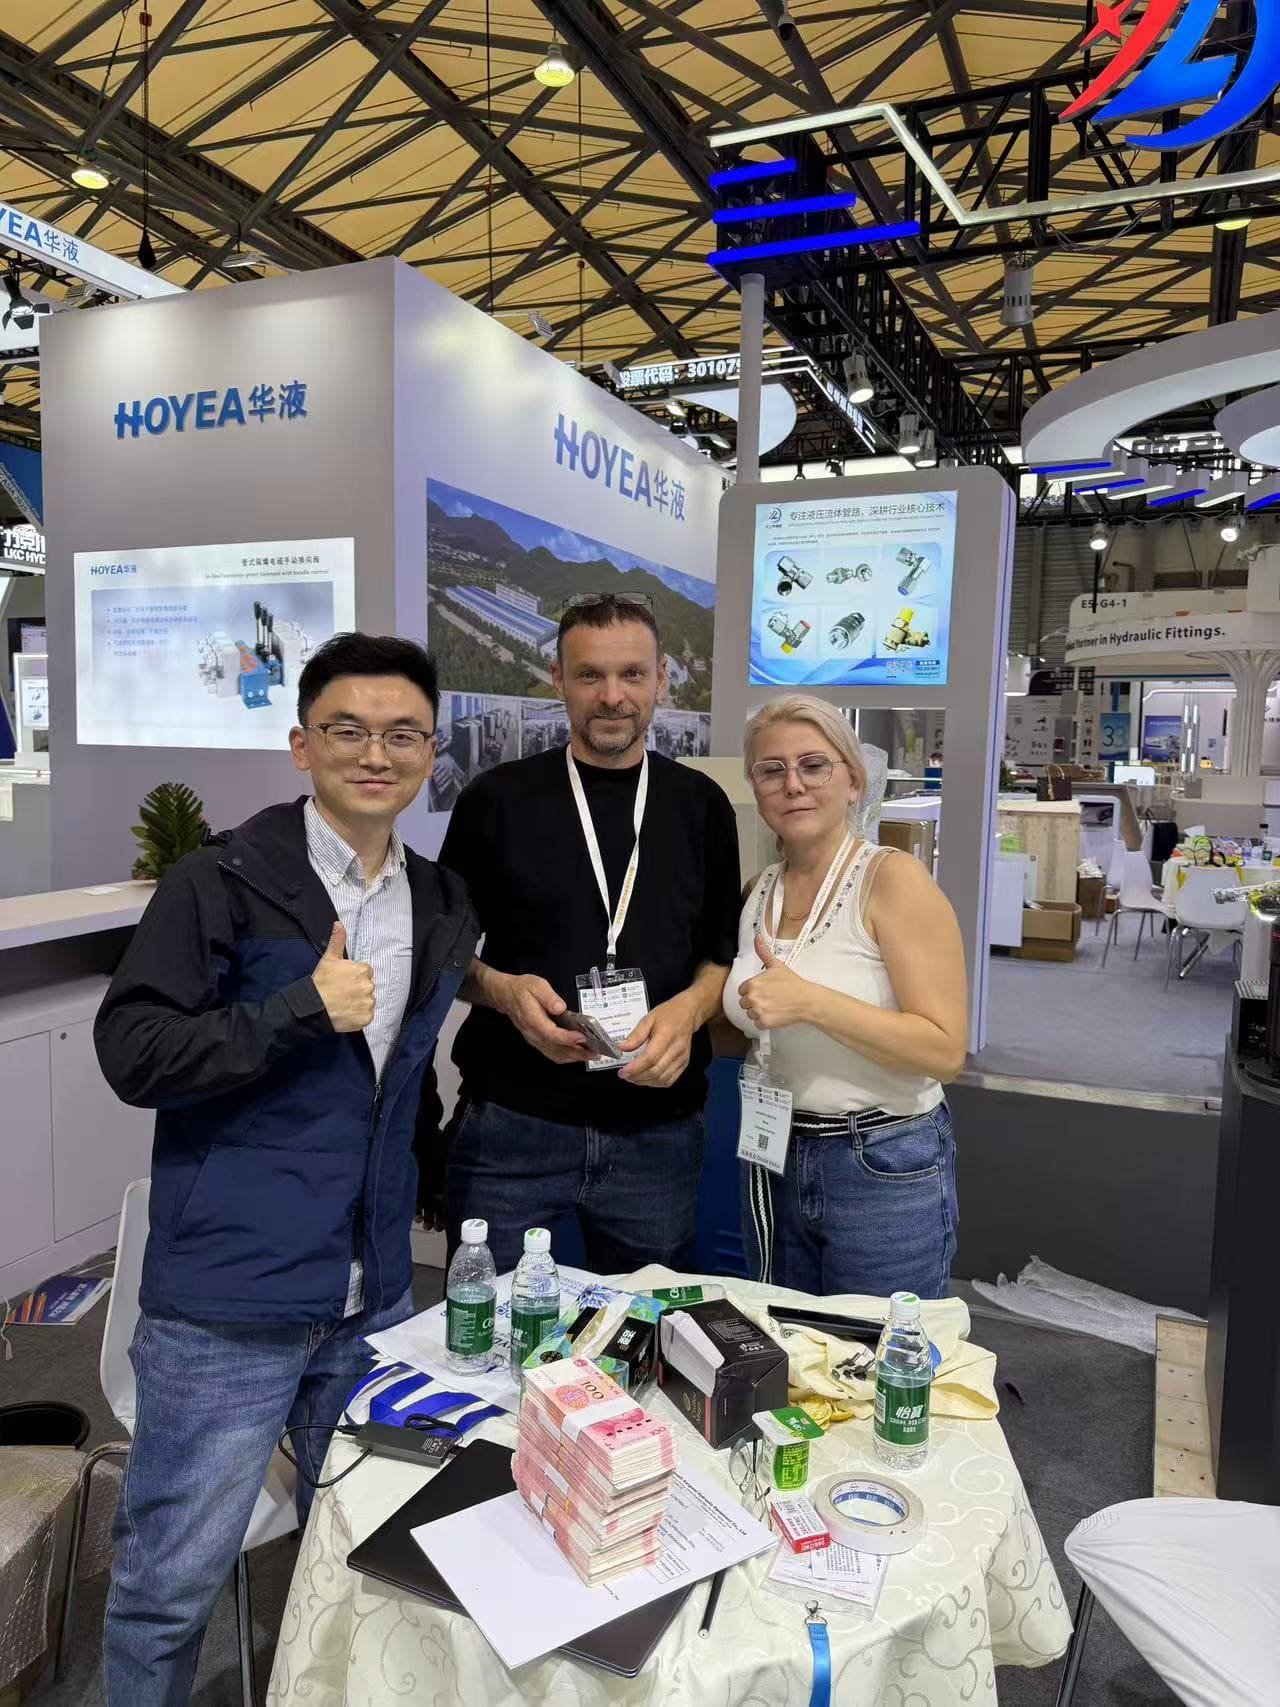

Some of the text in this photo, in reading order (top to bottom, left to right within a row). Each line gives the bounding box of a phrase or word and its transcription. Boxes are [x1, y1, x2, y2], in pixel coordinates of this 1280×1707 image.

[44, 229, 80, 263] 华液
[687, 358, 740, 378] 30107
[114, 380, 307, 440] HOYEA 华液
[554, 412, 685, 521] HOYEA 华液
[4, 547, 24, 561] LKC
[91, 565, 123, 575] HOYEA
[1081, 599, 1127, 608] E5-G4-1
[1099, 634, 1107, 645] in
[1109, 628, 1162, 646] Hydraulic
[1165, 625, 1226, 640] Fittings.
[581, 1380, 604, 1400] 100
